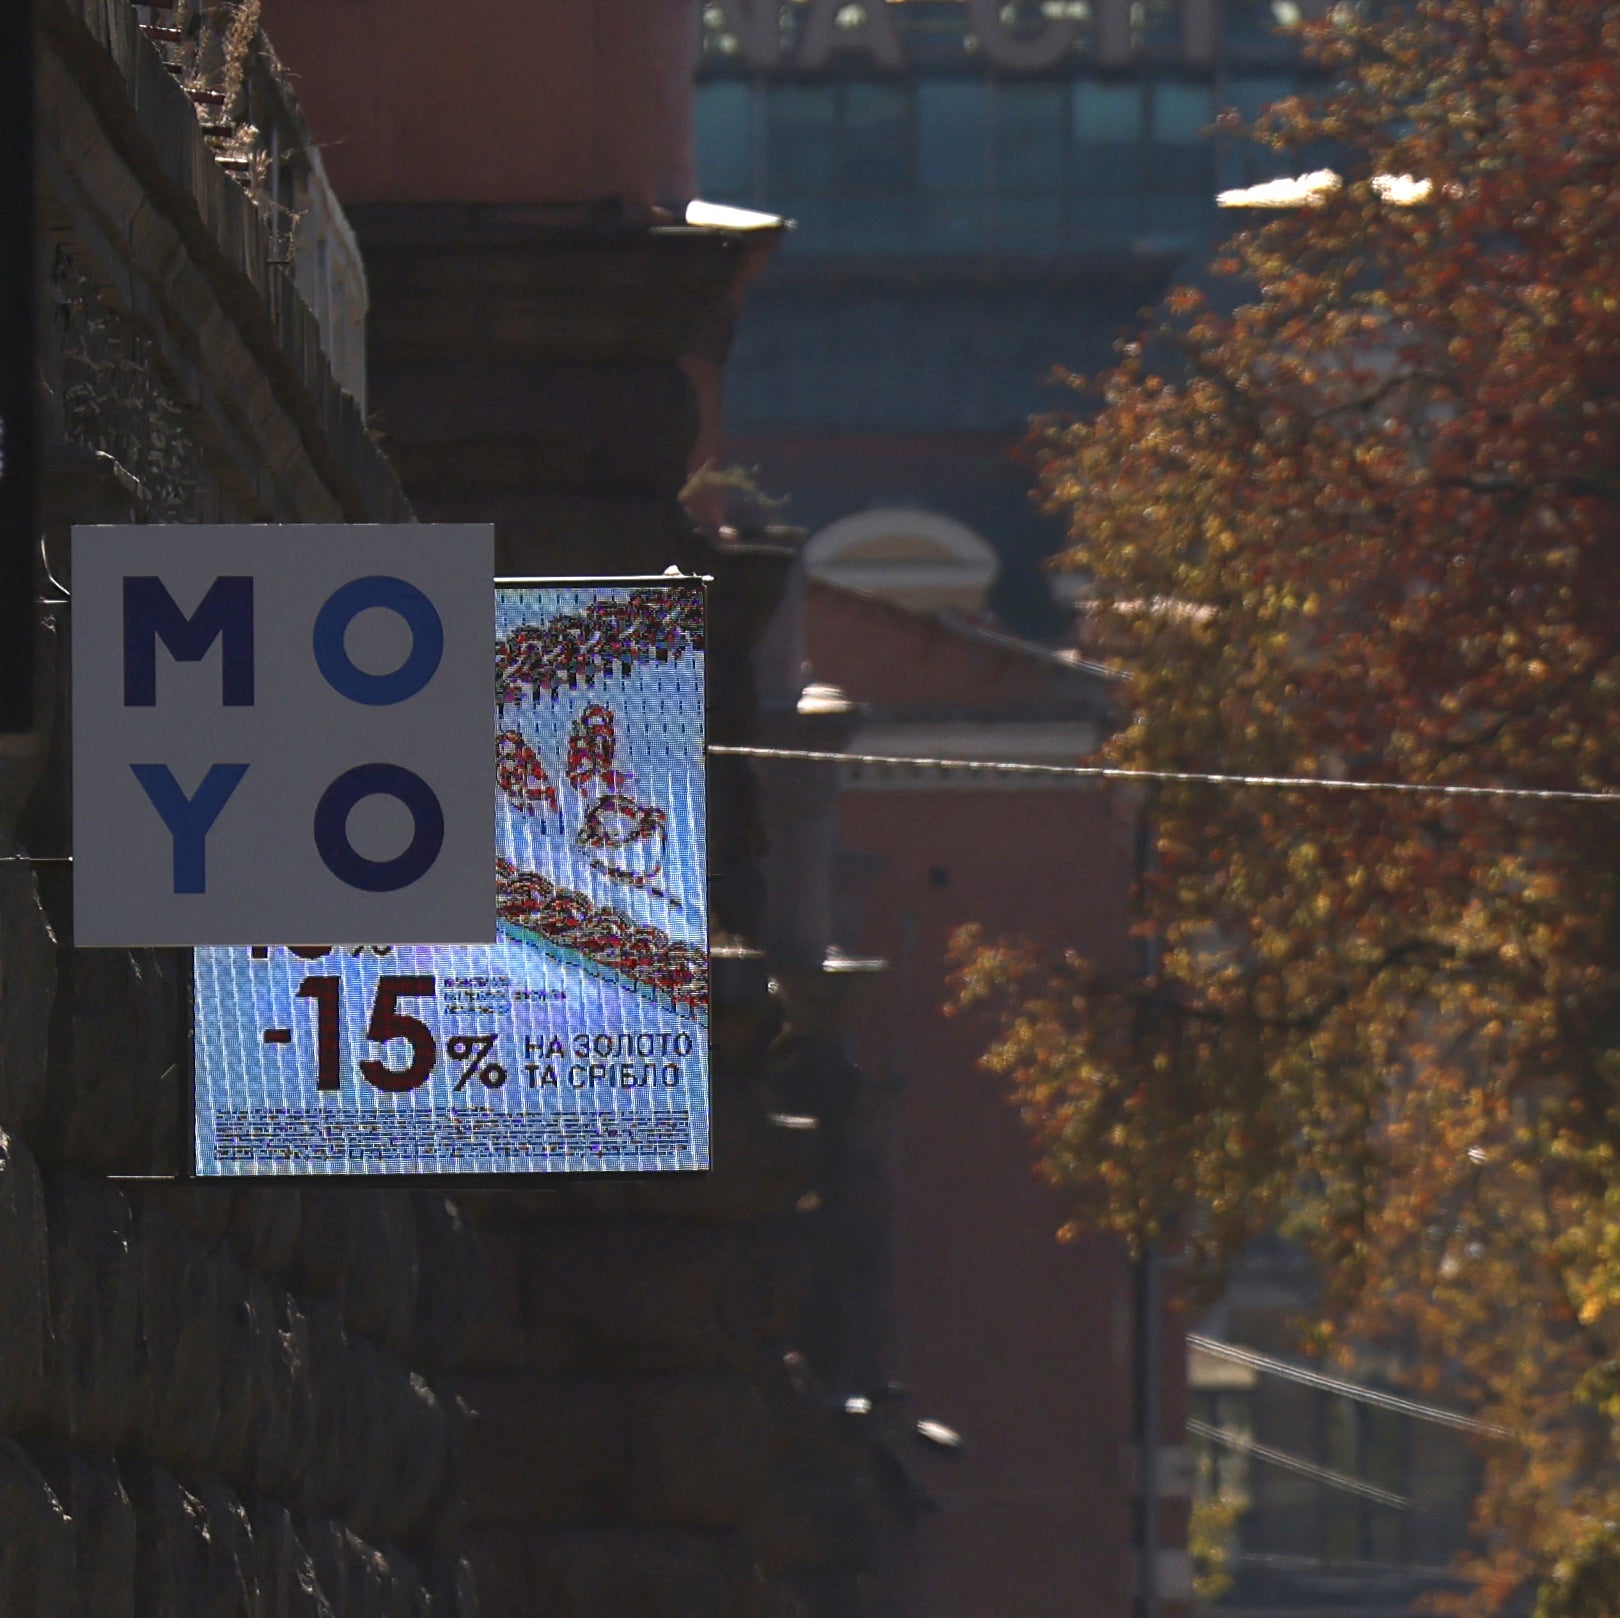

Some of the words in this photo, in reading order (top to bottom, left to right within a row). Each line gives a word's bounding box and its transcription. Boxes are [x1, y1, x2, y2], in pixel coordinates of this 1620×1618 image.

[262, 974, 507, 1093] -15%
[523, 1034, 567, 1058] НА
[574, 1031, 694, 1058] ЗОЛОТО
[524, 1064, 560, 1089] ТА
[568, 1062, 680, 1089] СРІБЛО
